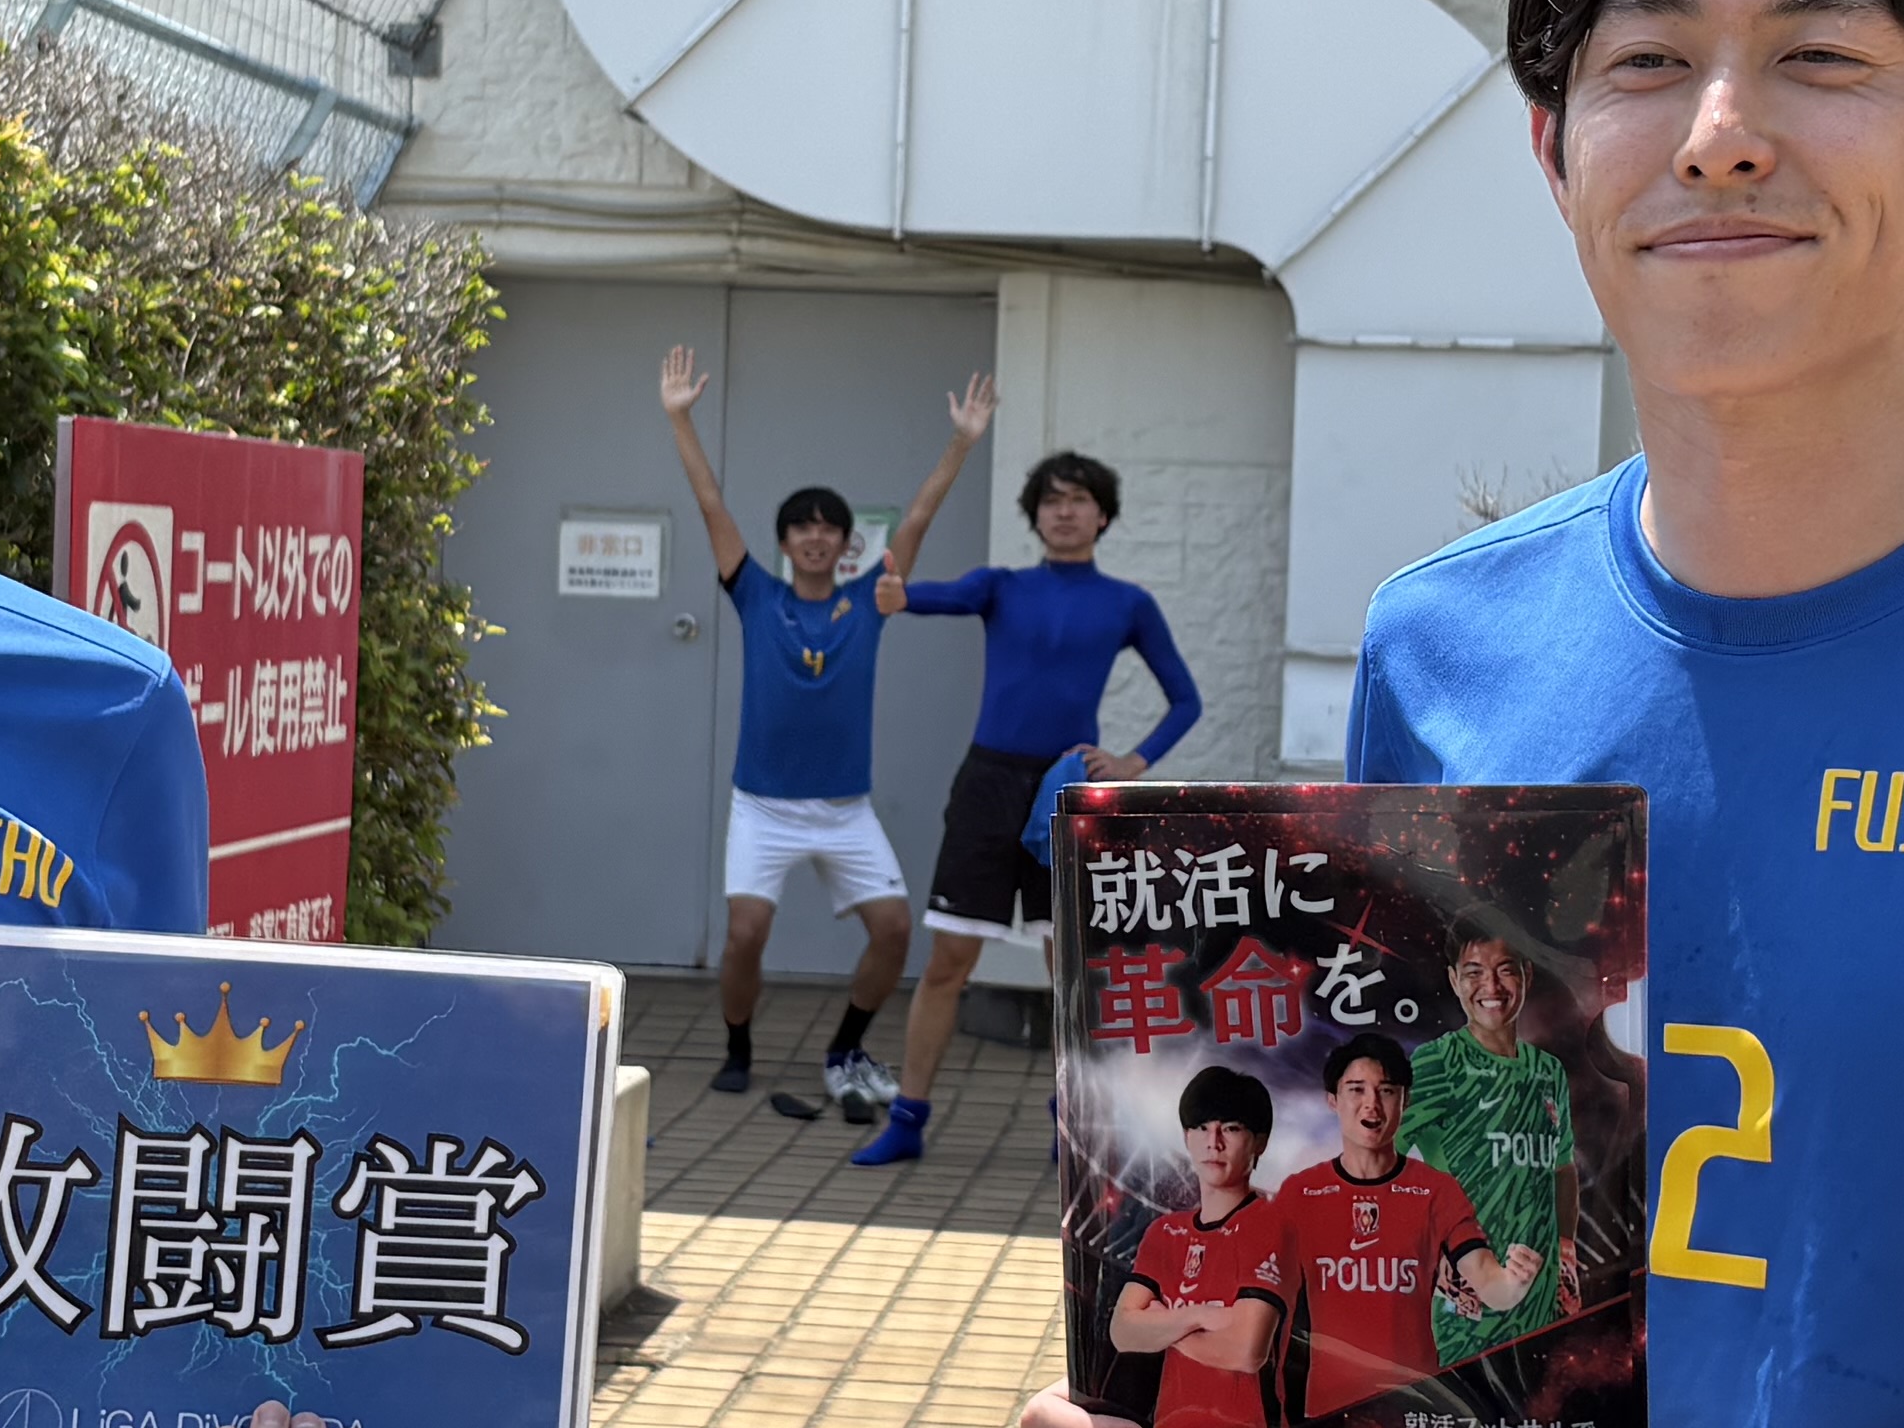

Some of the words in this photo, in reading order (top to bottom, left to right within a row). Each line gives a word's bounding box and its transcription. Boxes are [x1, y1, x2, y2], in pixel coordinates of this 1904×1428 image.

[178, 525, 354, 621] コート以外での
[802, 646, 825, 677] 4
[1086, 842, 1335, 933] 就活に
[1086, 935, 1419, 1054] 革命を。
[1649, 1022, 1775, 1290] 2
[1316, 1256, 1420, 1294] POLUS
